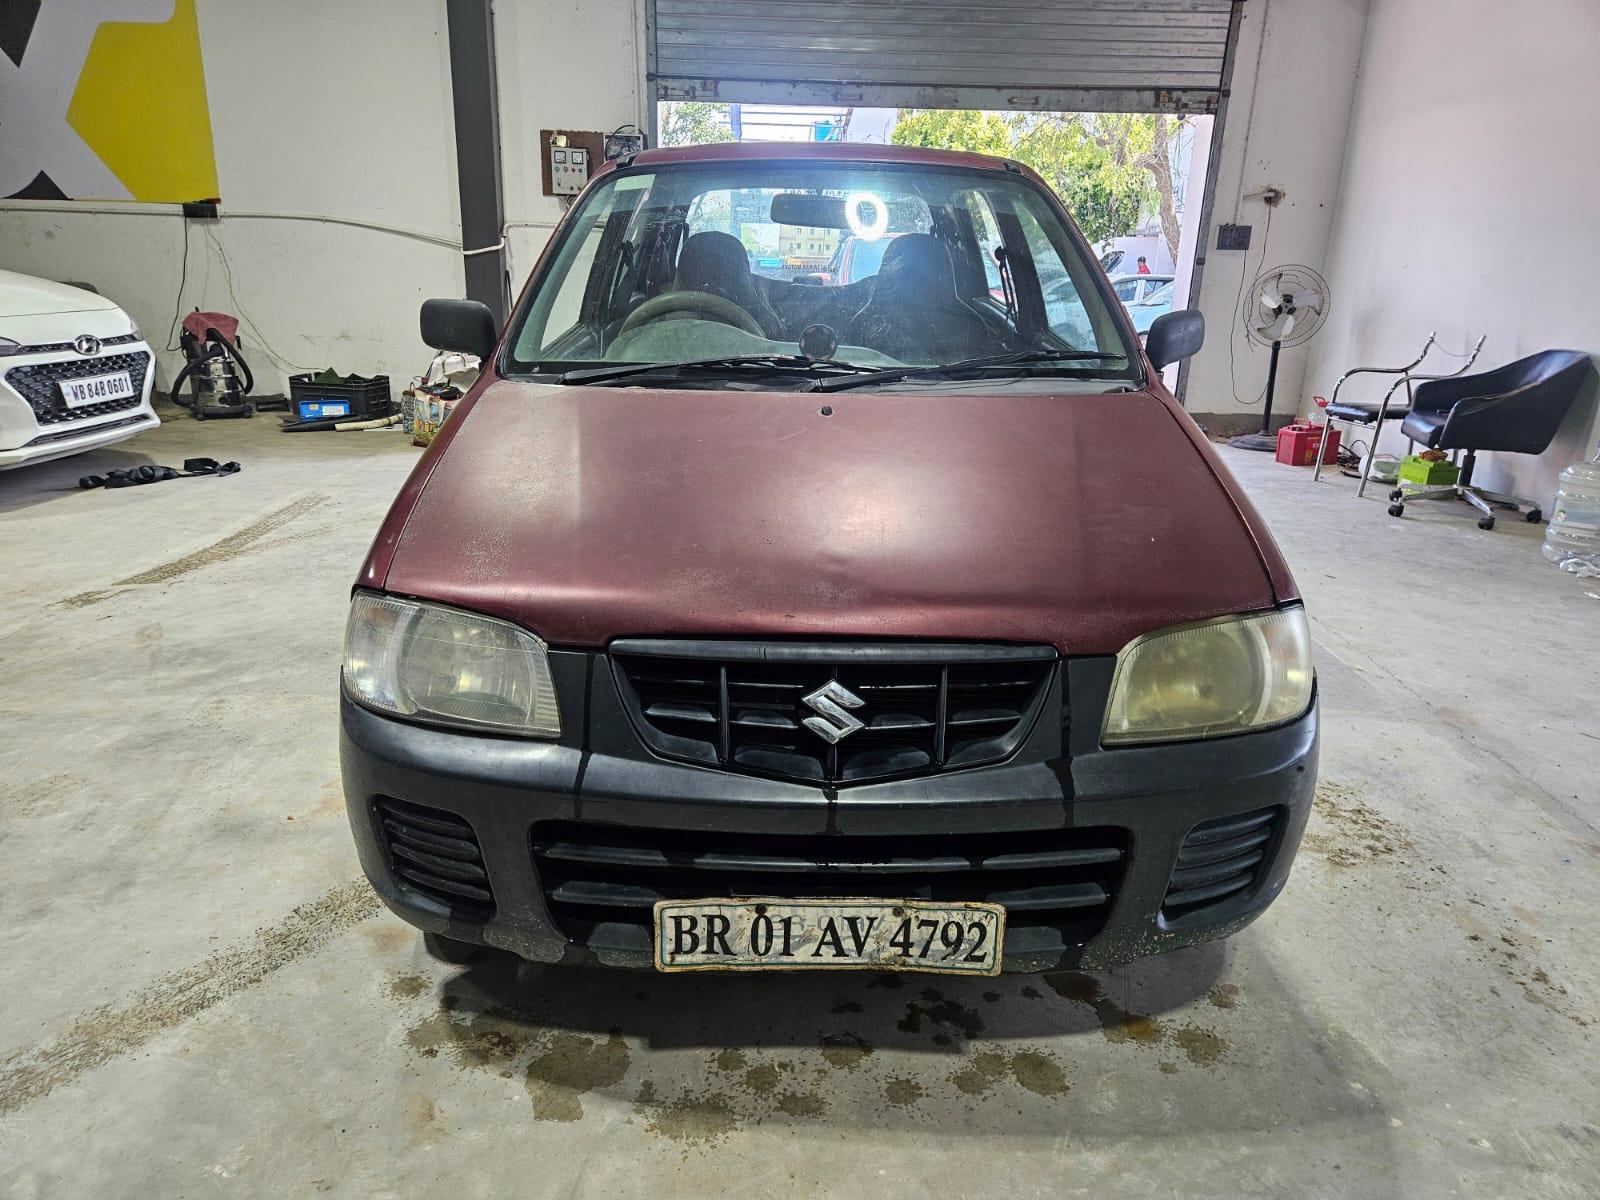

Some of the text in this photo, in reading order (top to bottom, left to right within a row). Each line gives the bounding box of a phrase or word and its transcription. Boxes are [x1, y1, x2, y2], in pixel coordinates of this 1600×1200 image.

[71, 383, 86, 401] WB
[668, 914, 988, 963] BR 01 AV 4792
